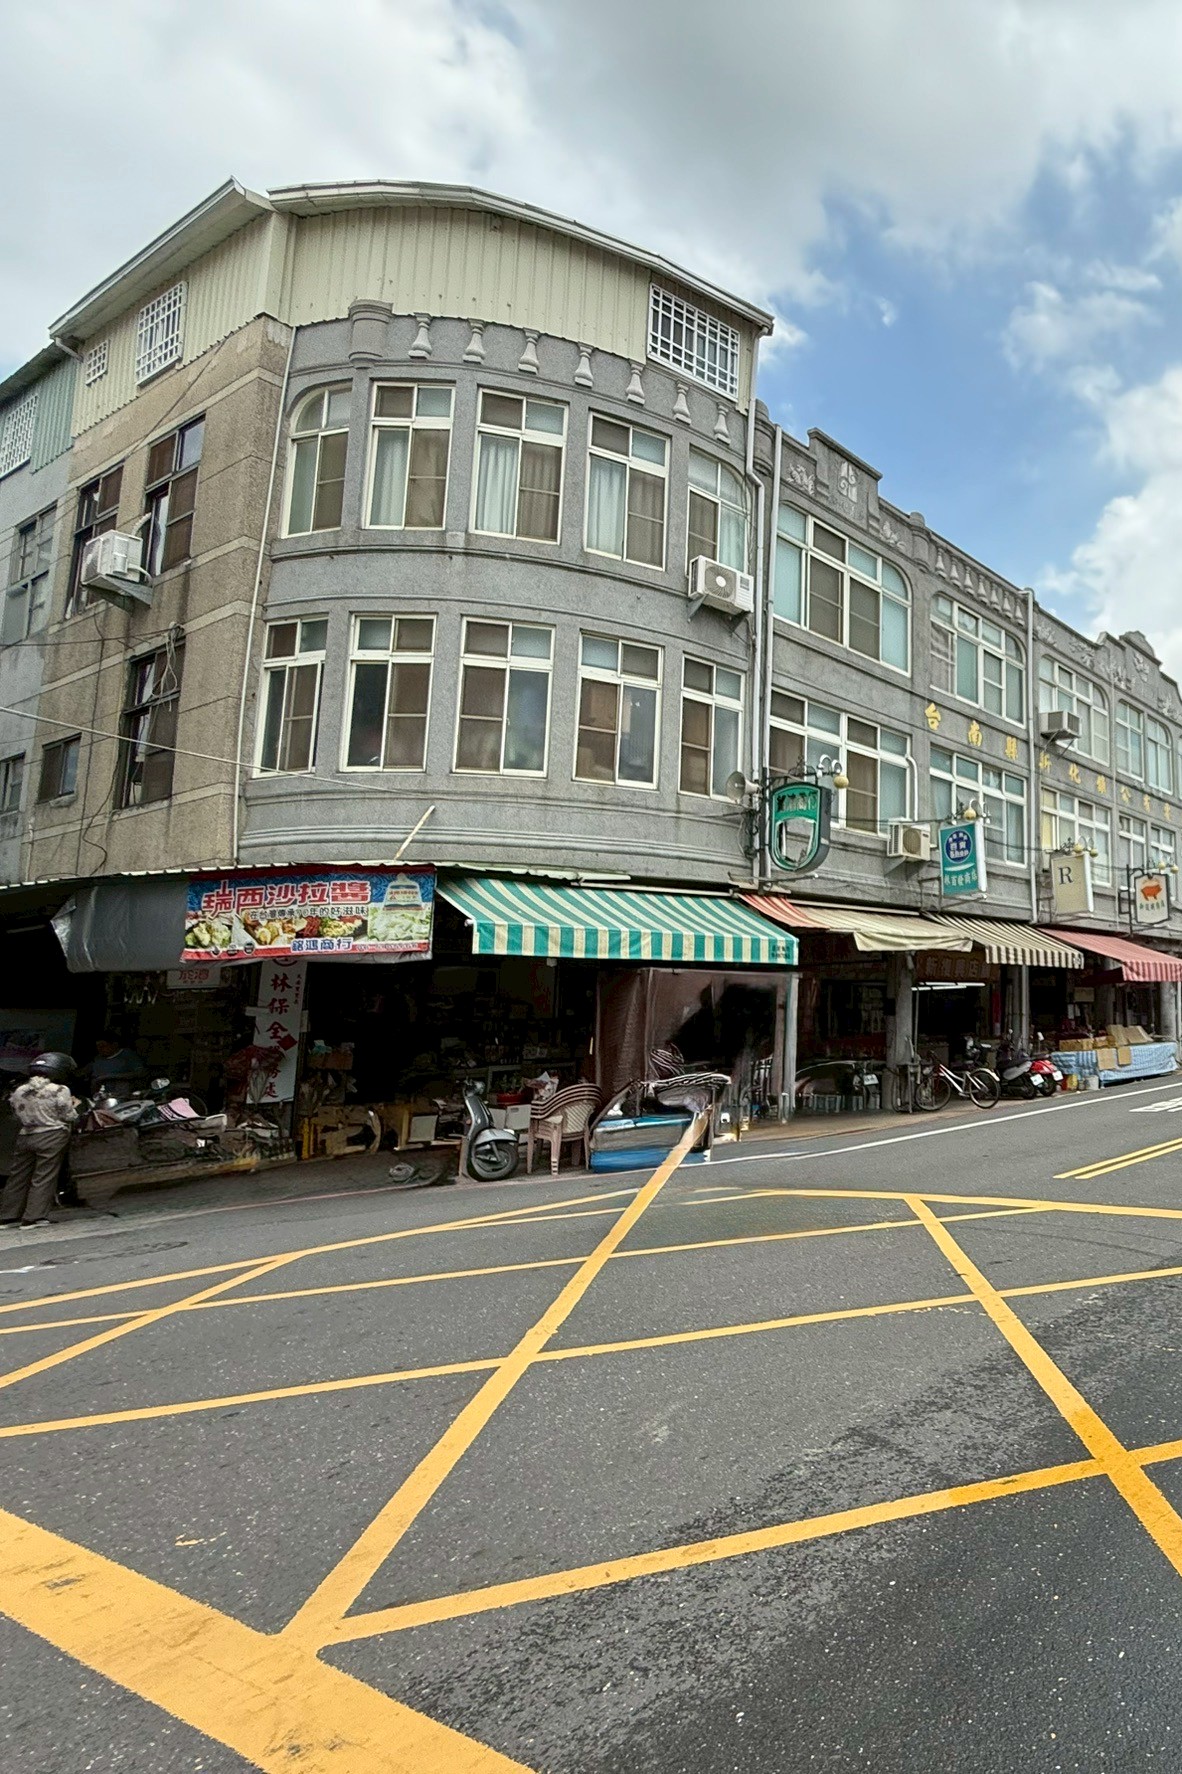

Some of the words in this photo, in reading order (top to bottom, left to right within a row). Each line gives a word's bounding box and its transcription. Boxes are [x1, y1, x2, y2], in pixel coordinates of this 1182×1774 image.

[1057, 866, 1074, 885] R
[202, 880, 371, 919] 瑞西沙拉醬
